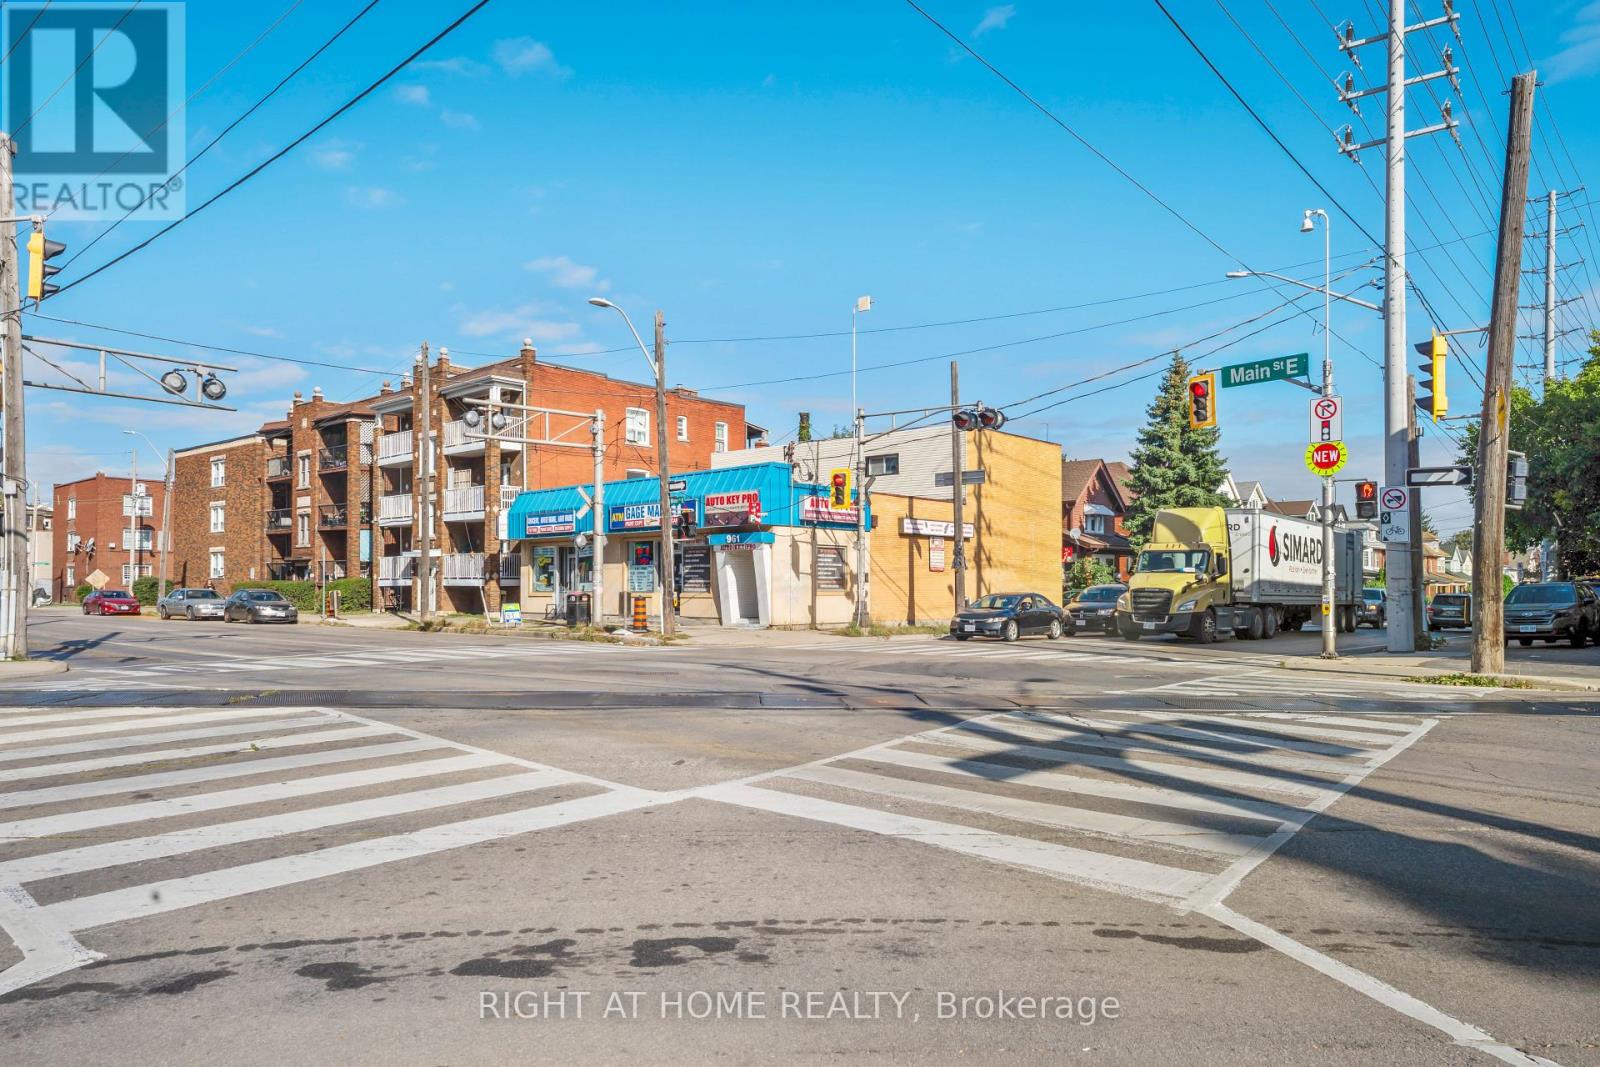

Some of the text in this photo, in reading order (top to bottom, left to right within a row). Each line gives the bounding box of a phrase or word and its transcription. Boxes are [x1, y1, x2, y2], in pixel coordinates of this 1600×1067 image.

[1230, 357, 1299, 384] Main St E
[1313, 450, 1339, 463] NEW
[705, 492, 758, 507] AUTO KEY PRO
[611, 512, 625, 523] ATM
[625, 505, 645, 520] GAGE
[726, 535, 740, 544] 961
[1283, 533, 1323, 565] SIMARD
